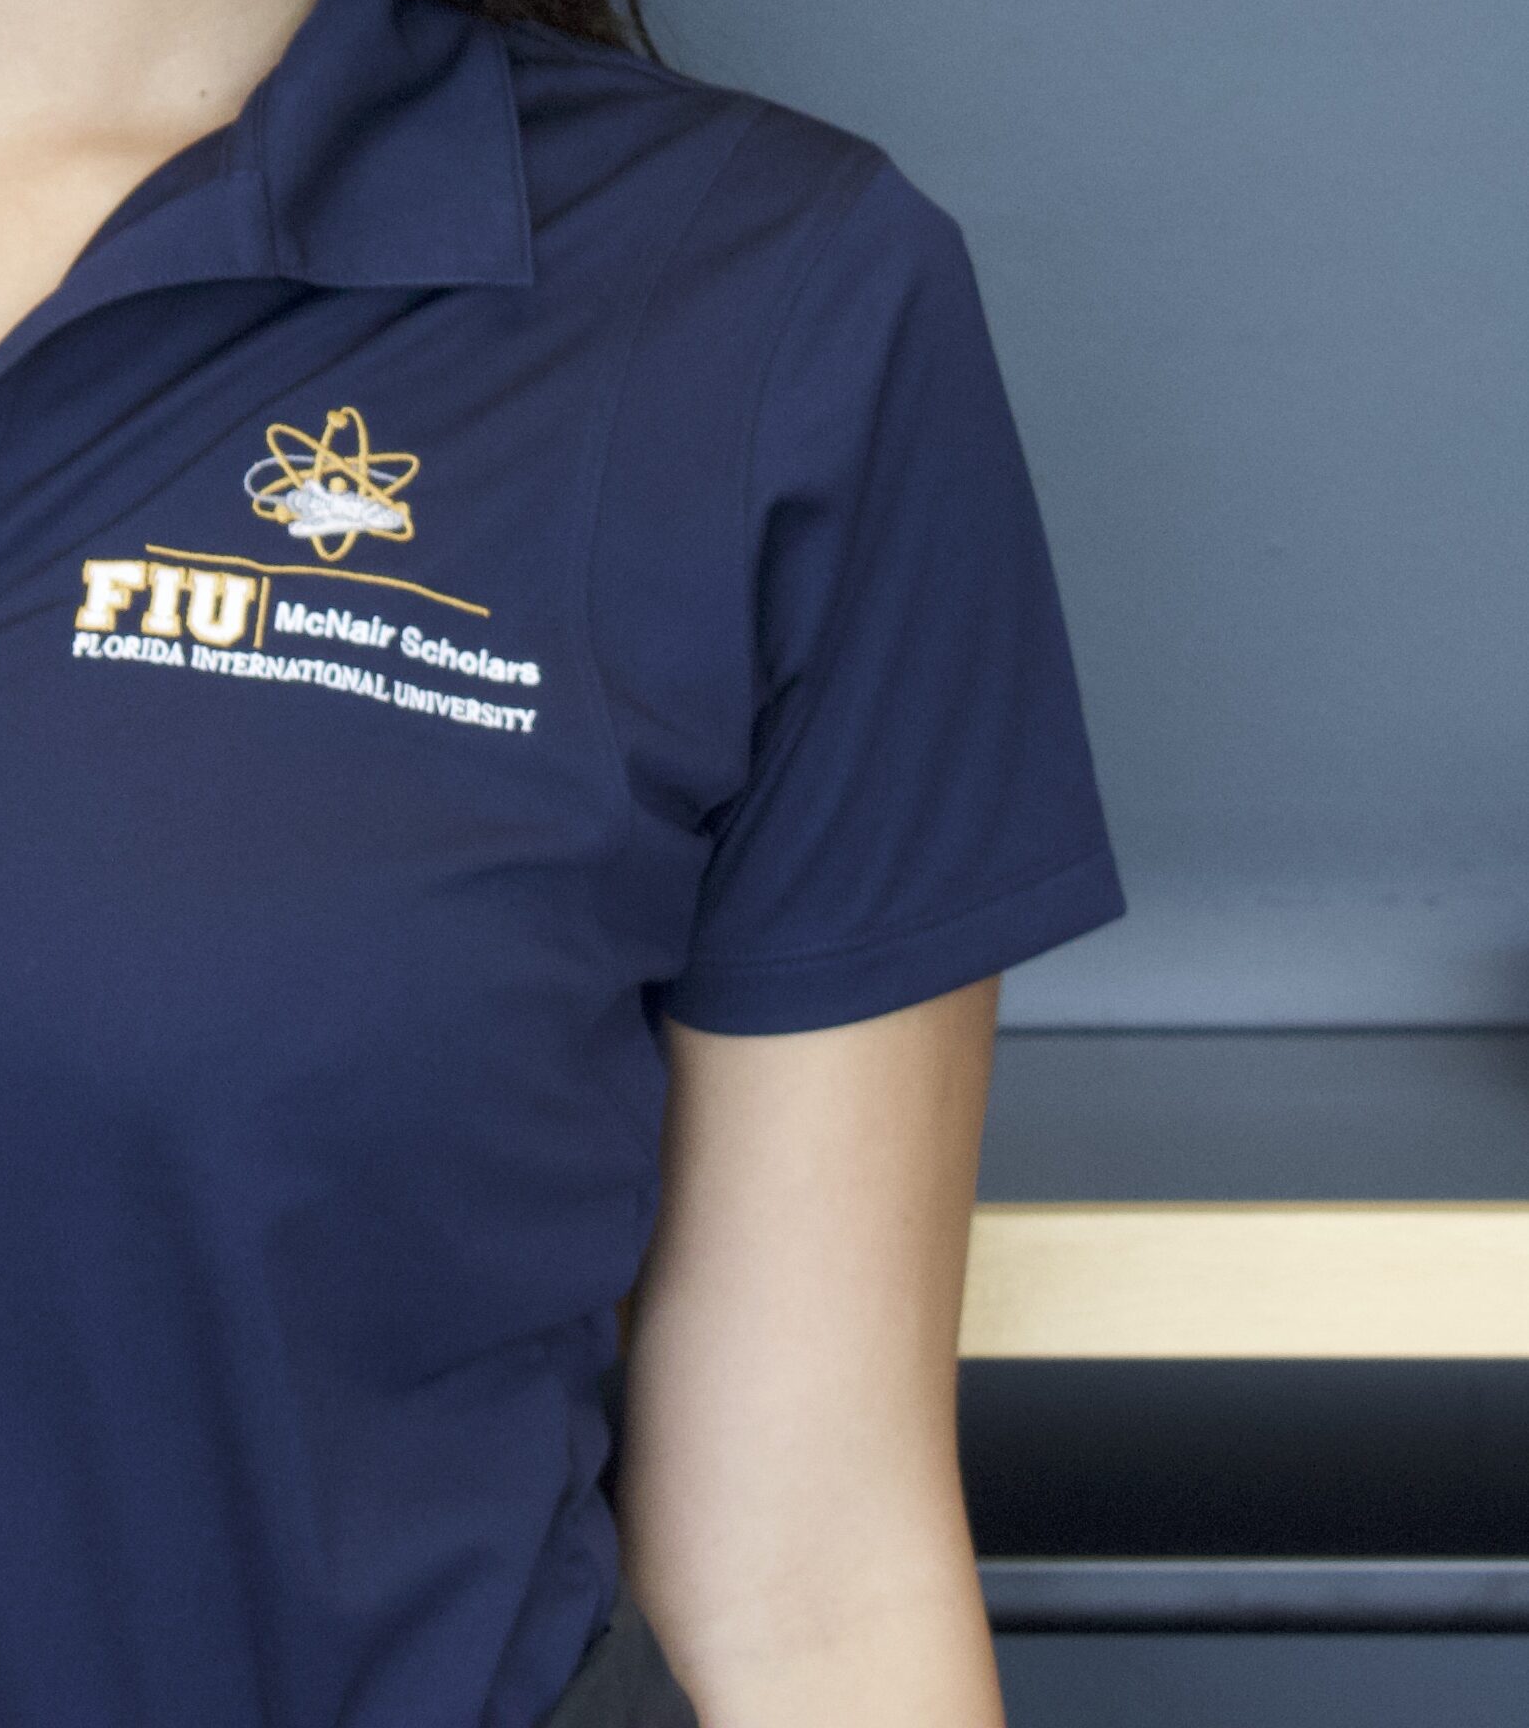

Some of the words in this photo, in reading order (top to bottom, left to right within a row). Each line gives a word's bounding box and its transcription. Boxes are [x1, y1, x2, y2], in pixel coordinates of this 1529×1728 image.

[74, 558, 257, 648] FIU
[274, 600, 397, 649] McNair
[400, 625, 542, 687] Scholars
[71, 631, 186, 668] FLORIDA
[190, 643, 392, 703] INTERNATIONAL
[393, 679, 537, 733] UNIVERSITY
